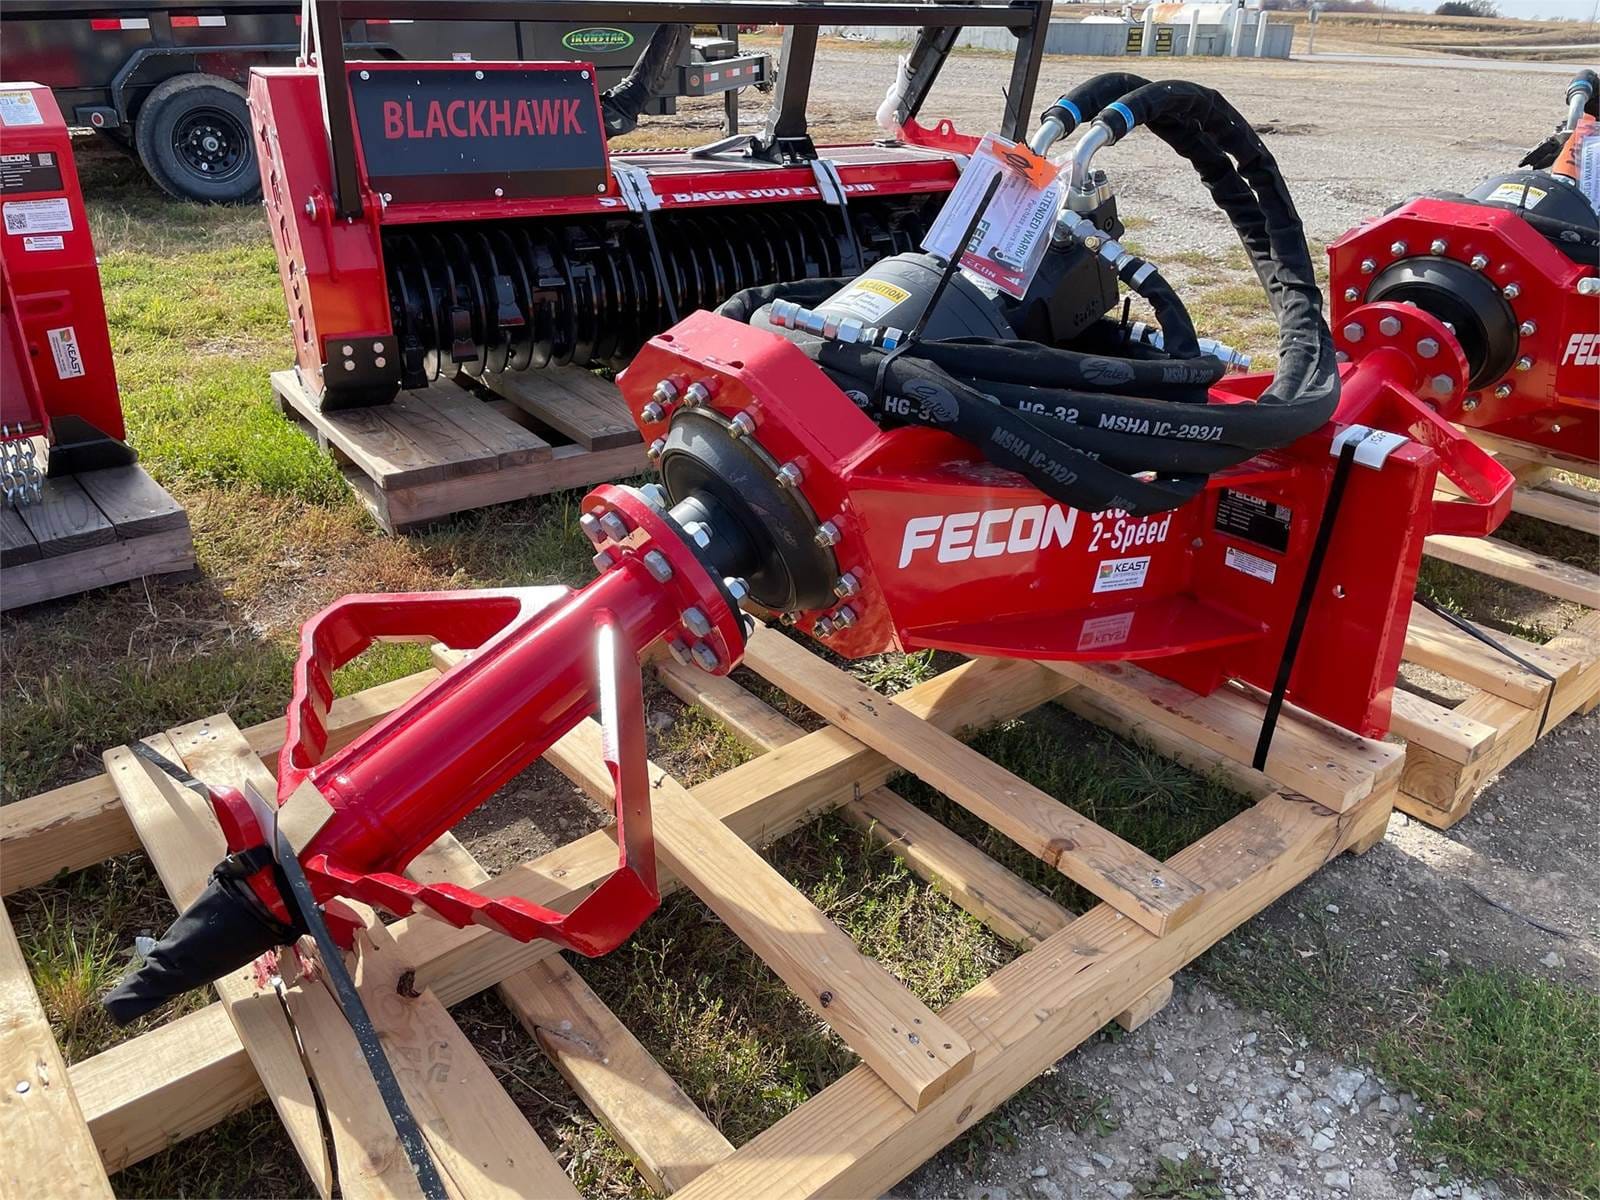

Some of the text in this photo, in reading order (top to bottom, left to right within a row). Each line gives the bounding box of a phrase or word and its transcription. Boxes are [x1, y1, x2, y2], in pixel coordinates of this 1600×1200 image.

[384, 100, 582, 139] BLACKHAWK
[0, 154, 30, 162] ECON
[673, 190, 745, 203] BACK
[1030, 190, 1056, 230] EXTENDED
[66, 343, 82, 375] KEAST
[1561, 333, 1600, 366] FEC
[884, 395, 937, 423] HG-3
[991, 425, 1031, 460] MSHA
[1098, 413, 1224, 441] MSHA IC-293/1
[1227, 488, 1267, 507] FECON
[898, 503, 1079, 569] FECON
[1087, 513, 1173, 554] 2-Speed
[1114, 560, 1149, 573] KEAST
